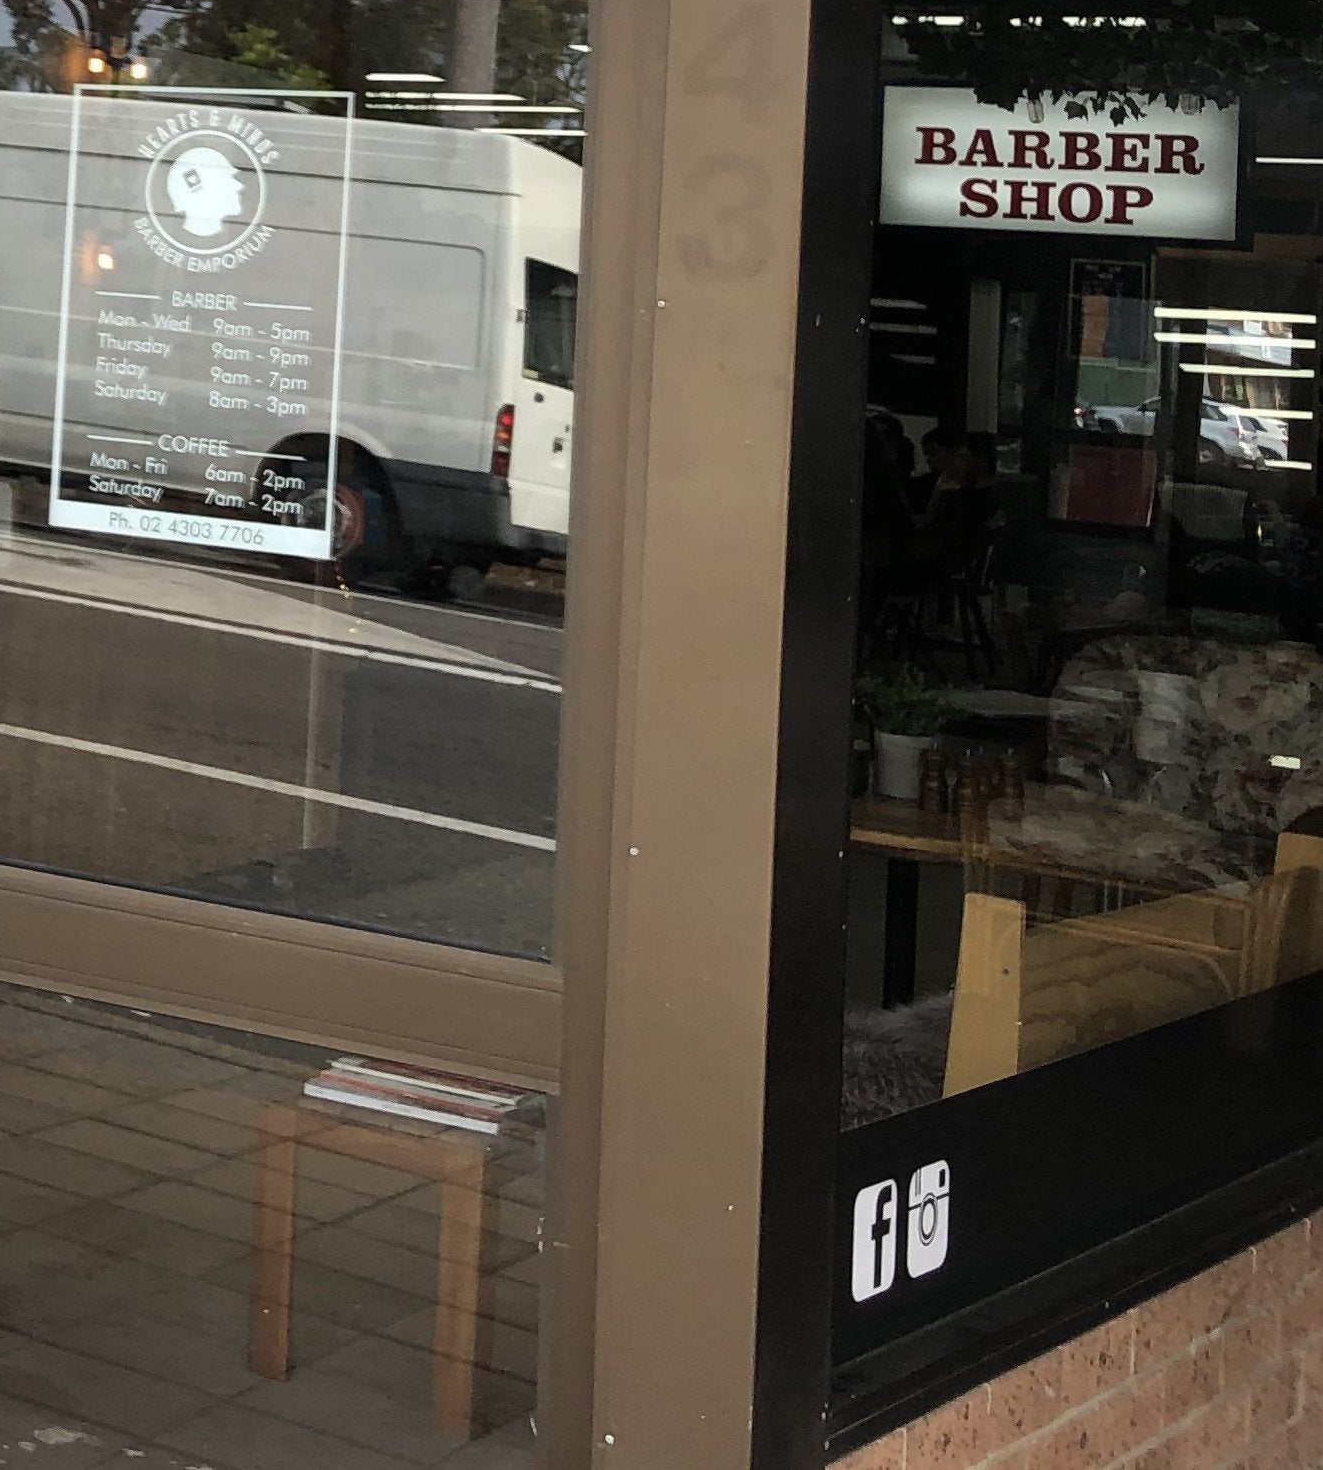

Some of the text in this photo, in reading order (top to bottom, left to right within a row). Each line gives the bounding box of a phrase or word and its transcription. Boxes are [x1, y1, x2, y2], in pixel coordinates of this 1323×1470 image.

[137, 109, 199, 160] HEARTS
[227, 114, 281, 165] MINDS
[915, 125, 1206, 176] BARBER
[959, 178, 1154, 226] SHOP
[132, 216, 277, 274] BARBER EMPORIUM
[172, 290, 238, 311] BARBER
[98, 310, 137, 328] Mon
[153, 313, 192, 333] Wed
[213, 318, 253, 337] 9am
[270, 322, 310, 346] 5pm
[97, 332, 172, 358] Thursday
[211, 341, 250, 361] 9am
[269, 347, 310, 368] 9pm
[96, 356, 147, 380] Friday
[210, 366, 250, 386] 9am
[268, 371, 308, 393] 7pm
[95, 380, 167, 406] Saturday
[209, 390, 249, 410] 8am
[266, 396, 308, 417] 3pm
[157, 434, 231, 458] COFFEE
[90, 452, 129, 472] Mon
[145, 456, 168, 475] Fri
[204, 463, 245, 483] 6am
[263, 468, 305, 492] 2pm
[88, 475, 163, 504] Saturday
[203, 488, 245, 508] 7am
[261, 494, 304, 516] 2pm
[109, 511, 264, 546] Ph. 02 4303 7706
